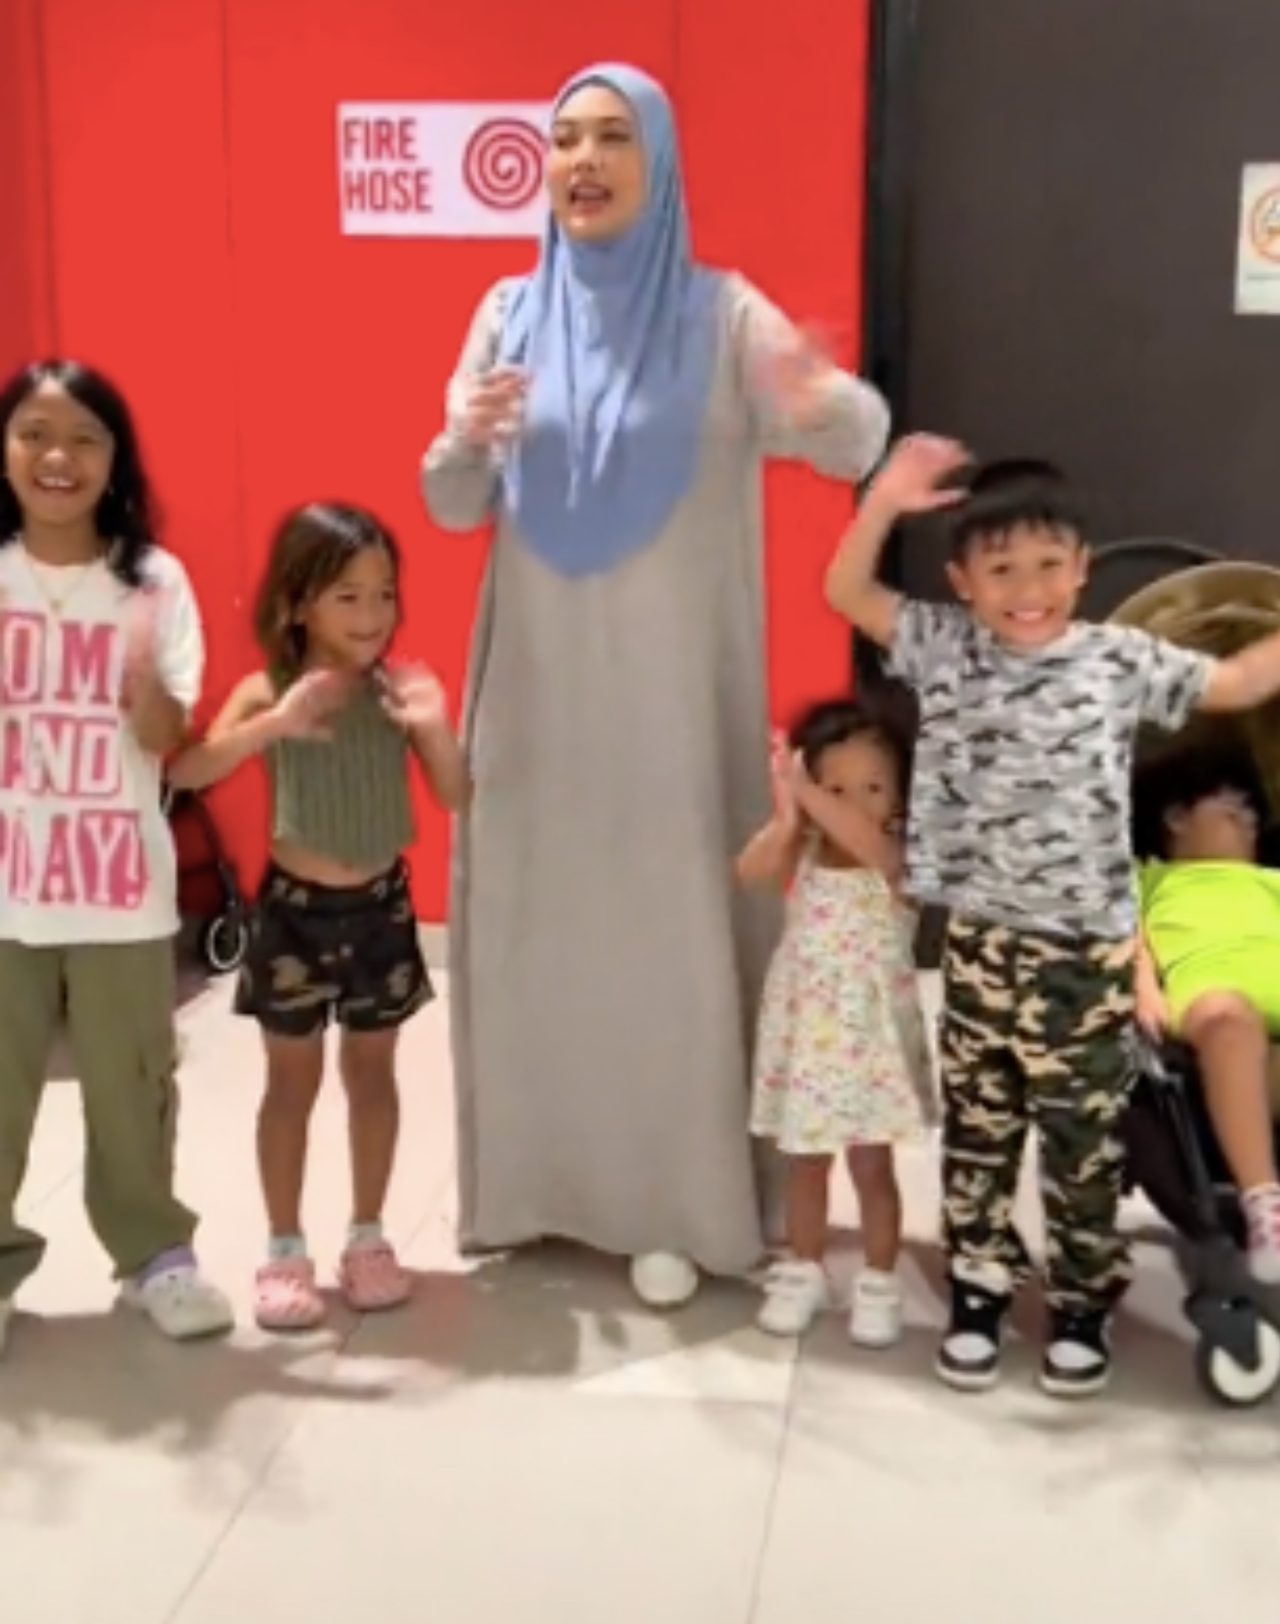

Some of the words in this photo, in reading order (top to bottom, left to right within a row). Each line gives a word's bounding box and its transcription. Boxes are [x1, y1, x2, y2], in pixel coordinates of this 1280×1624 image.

[343, 117, 416, 161] FIRE
[344, 169, 433, 214] HOSE
[1, 712, 121, 797] AND
